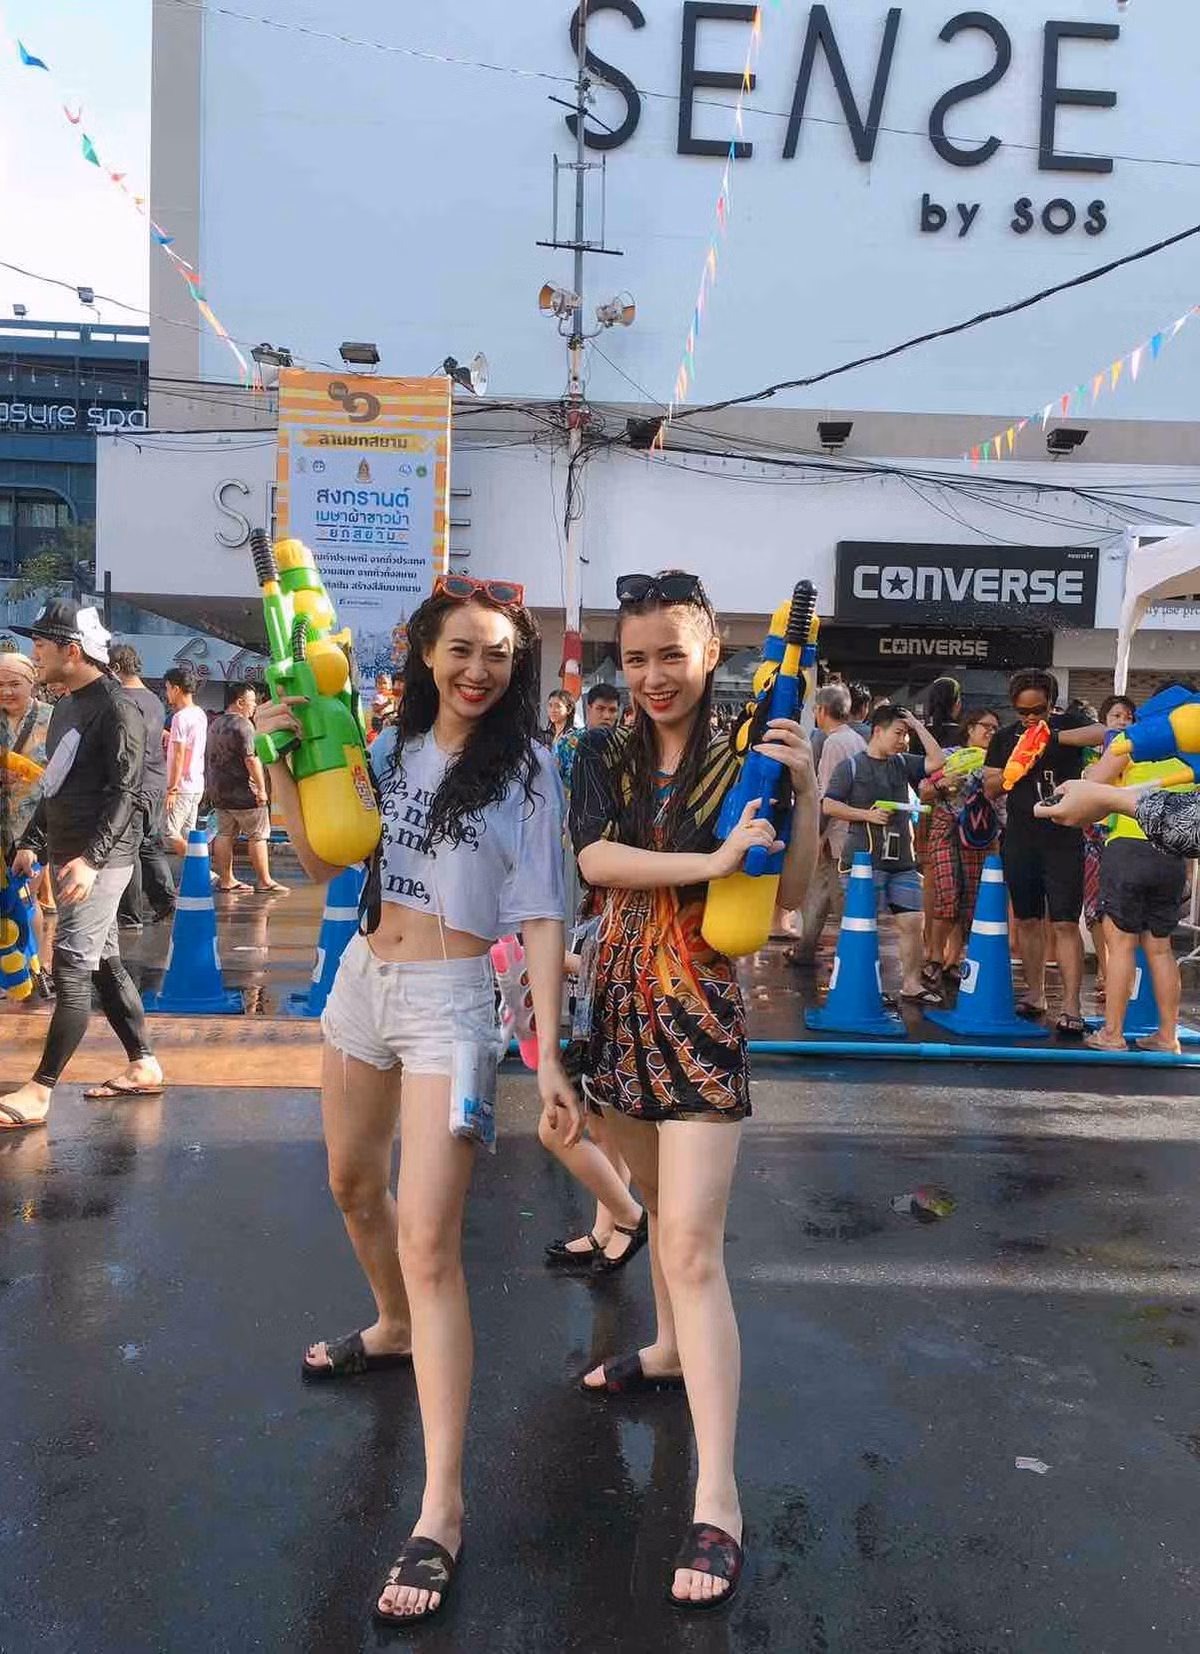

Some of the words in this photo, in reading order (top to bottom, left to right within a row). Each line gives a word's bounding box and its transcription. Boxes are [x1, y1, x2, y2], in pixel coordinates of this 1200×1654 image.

[565, 0, 1120, 173] SENSE
[920, 193, 981, 238] by
[316, 487, 411, 508] สงกรานต์
[853, 565, 1084, 605] CONVERSE
[879, 637, 989, 657] CONVERSE
[384, 873, 431, 905] me,
